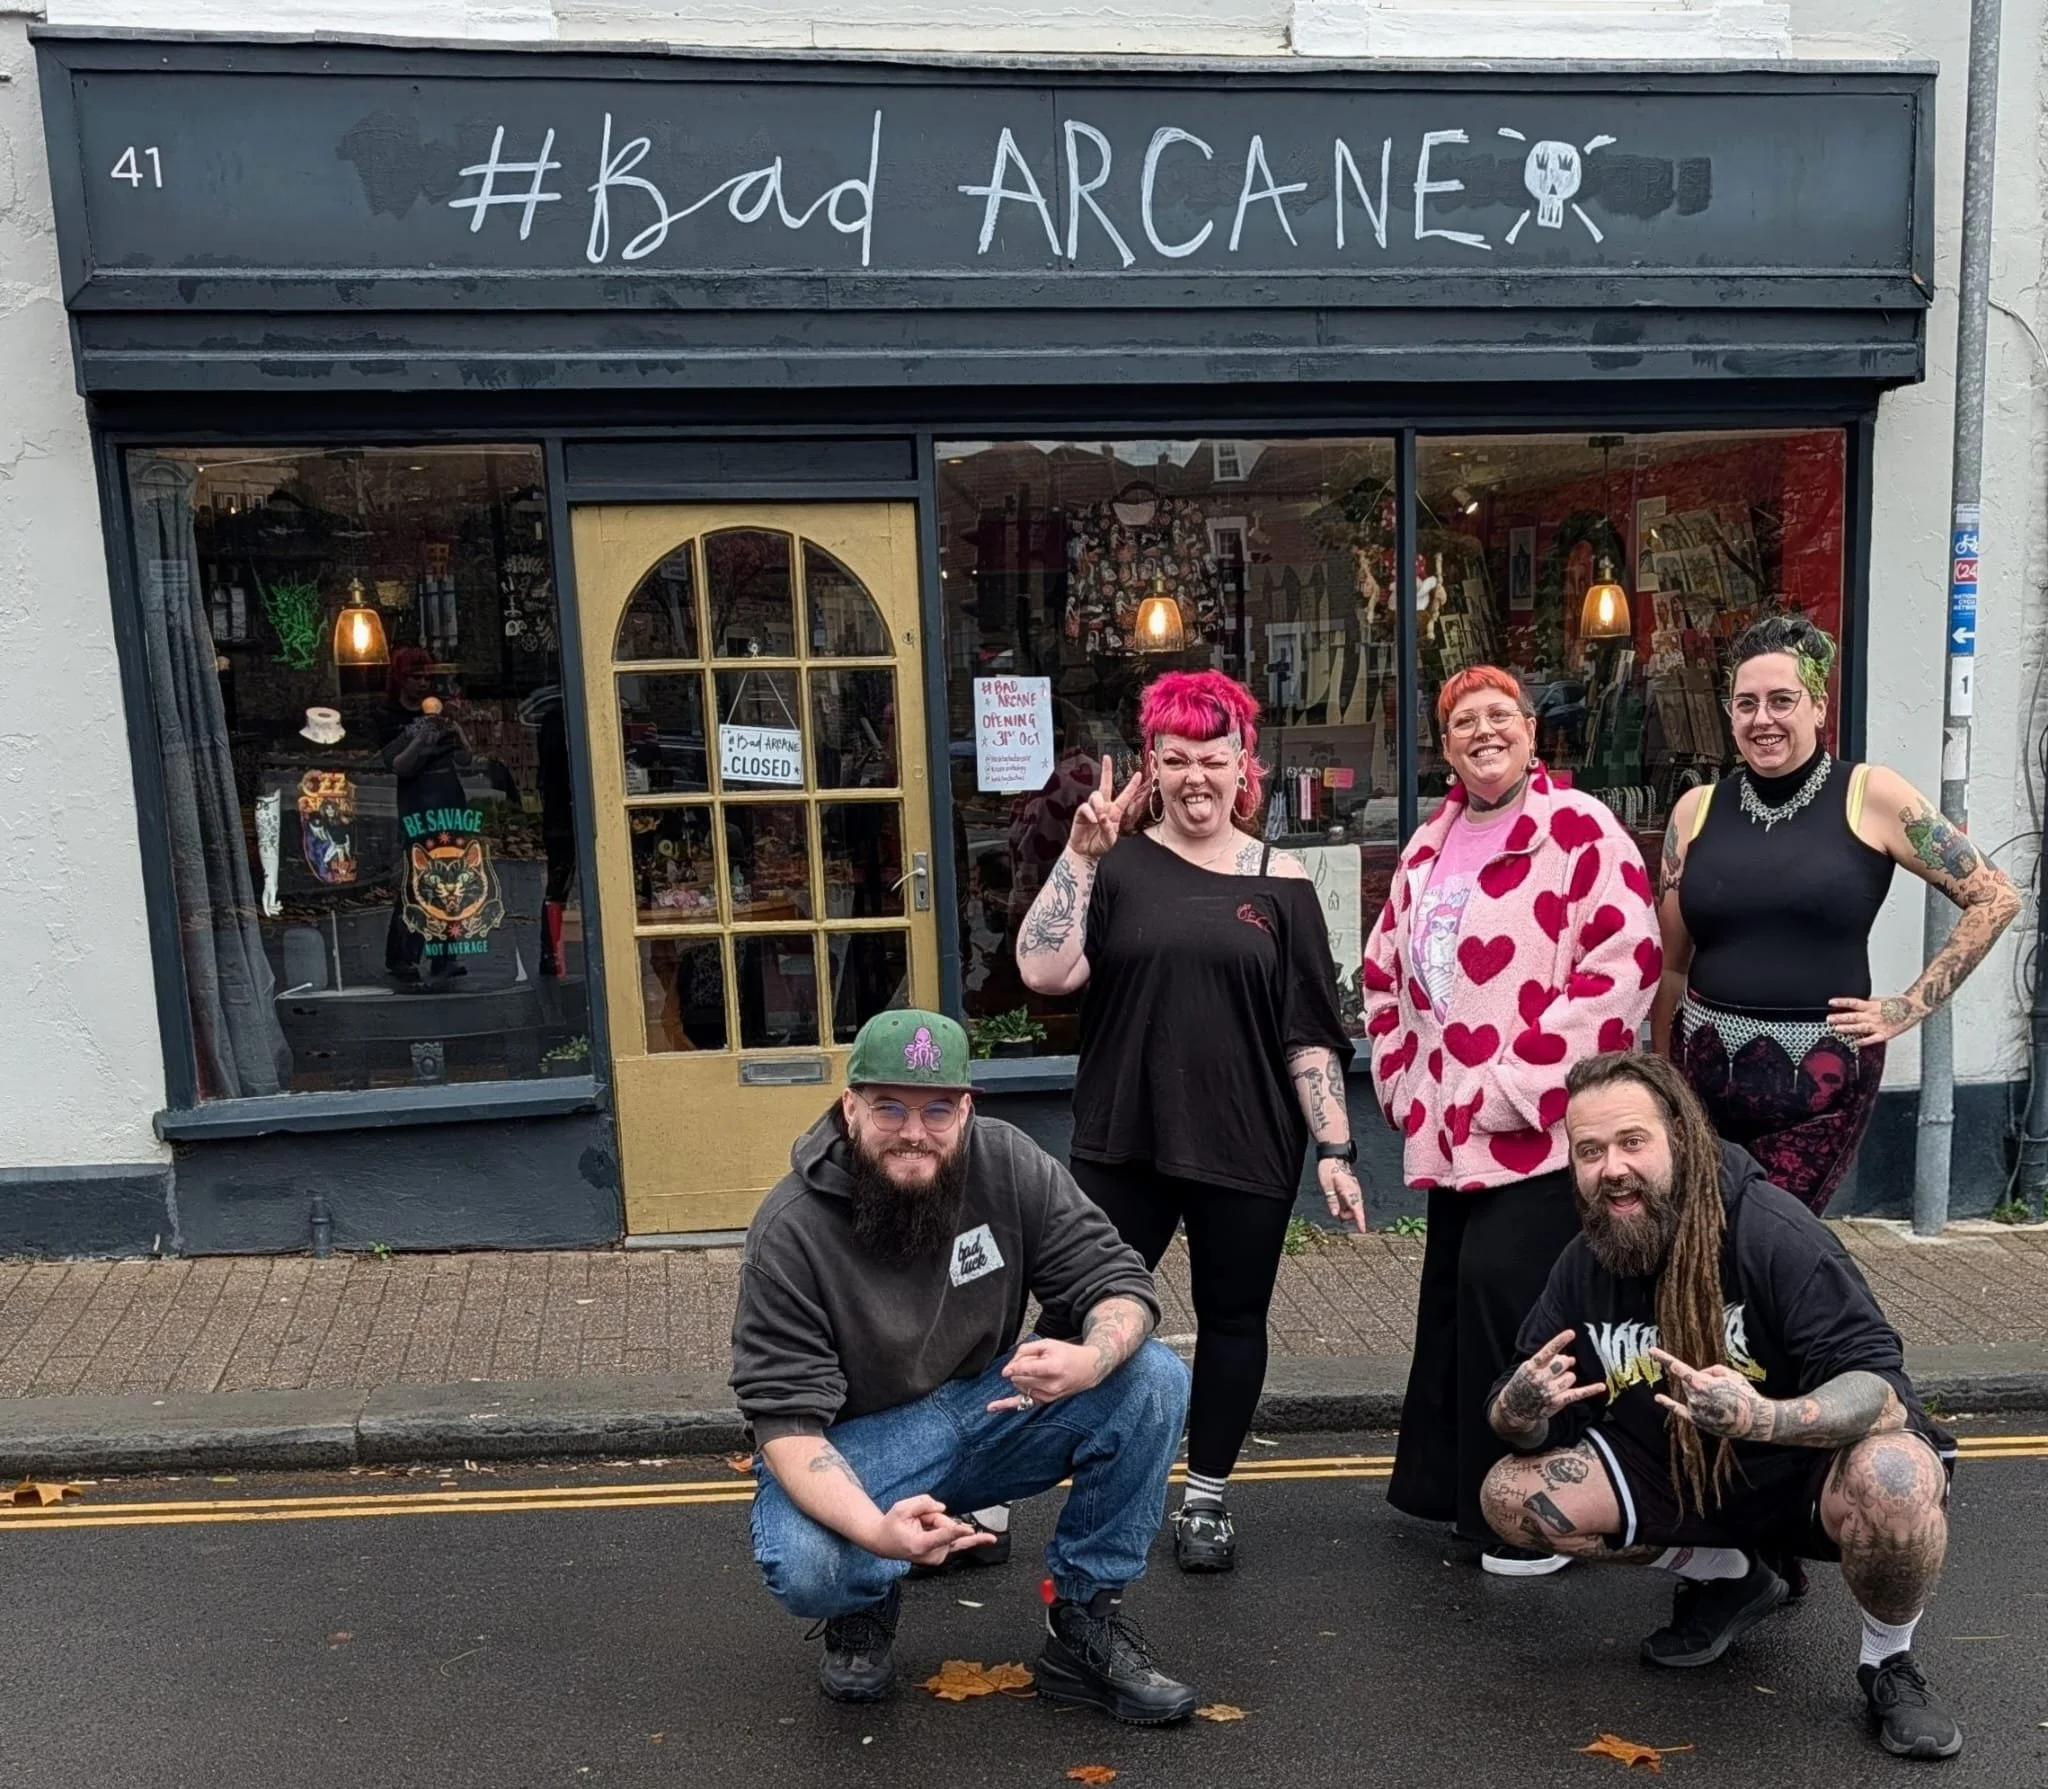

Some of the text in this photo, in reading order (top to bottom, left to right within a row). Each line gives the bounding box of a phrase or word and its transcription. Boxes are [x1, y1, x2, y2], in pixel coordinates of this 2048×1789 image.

[110, 146, 163, 188] 41
[957, 119, 1491, 267] ARCANE
[1962, 676, 1968, 694] 1
[998, 692, 1037, 708] ARCANE
[983, 712, 1036, 728] OPENING
[731, 756, 791, 777] CLOSED
[403, 807, 484, 838] BE SAVAGE
[424, 940, 489, 957] NOT AVERAGE
[958, 1233, 981, 1261] bad
[961, 1247, 988, 1275] luck
